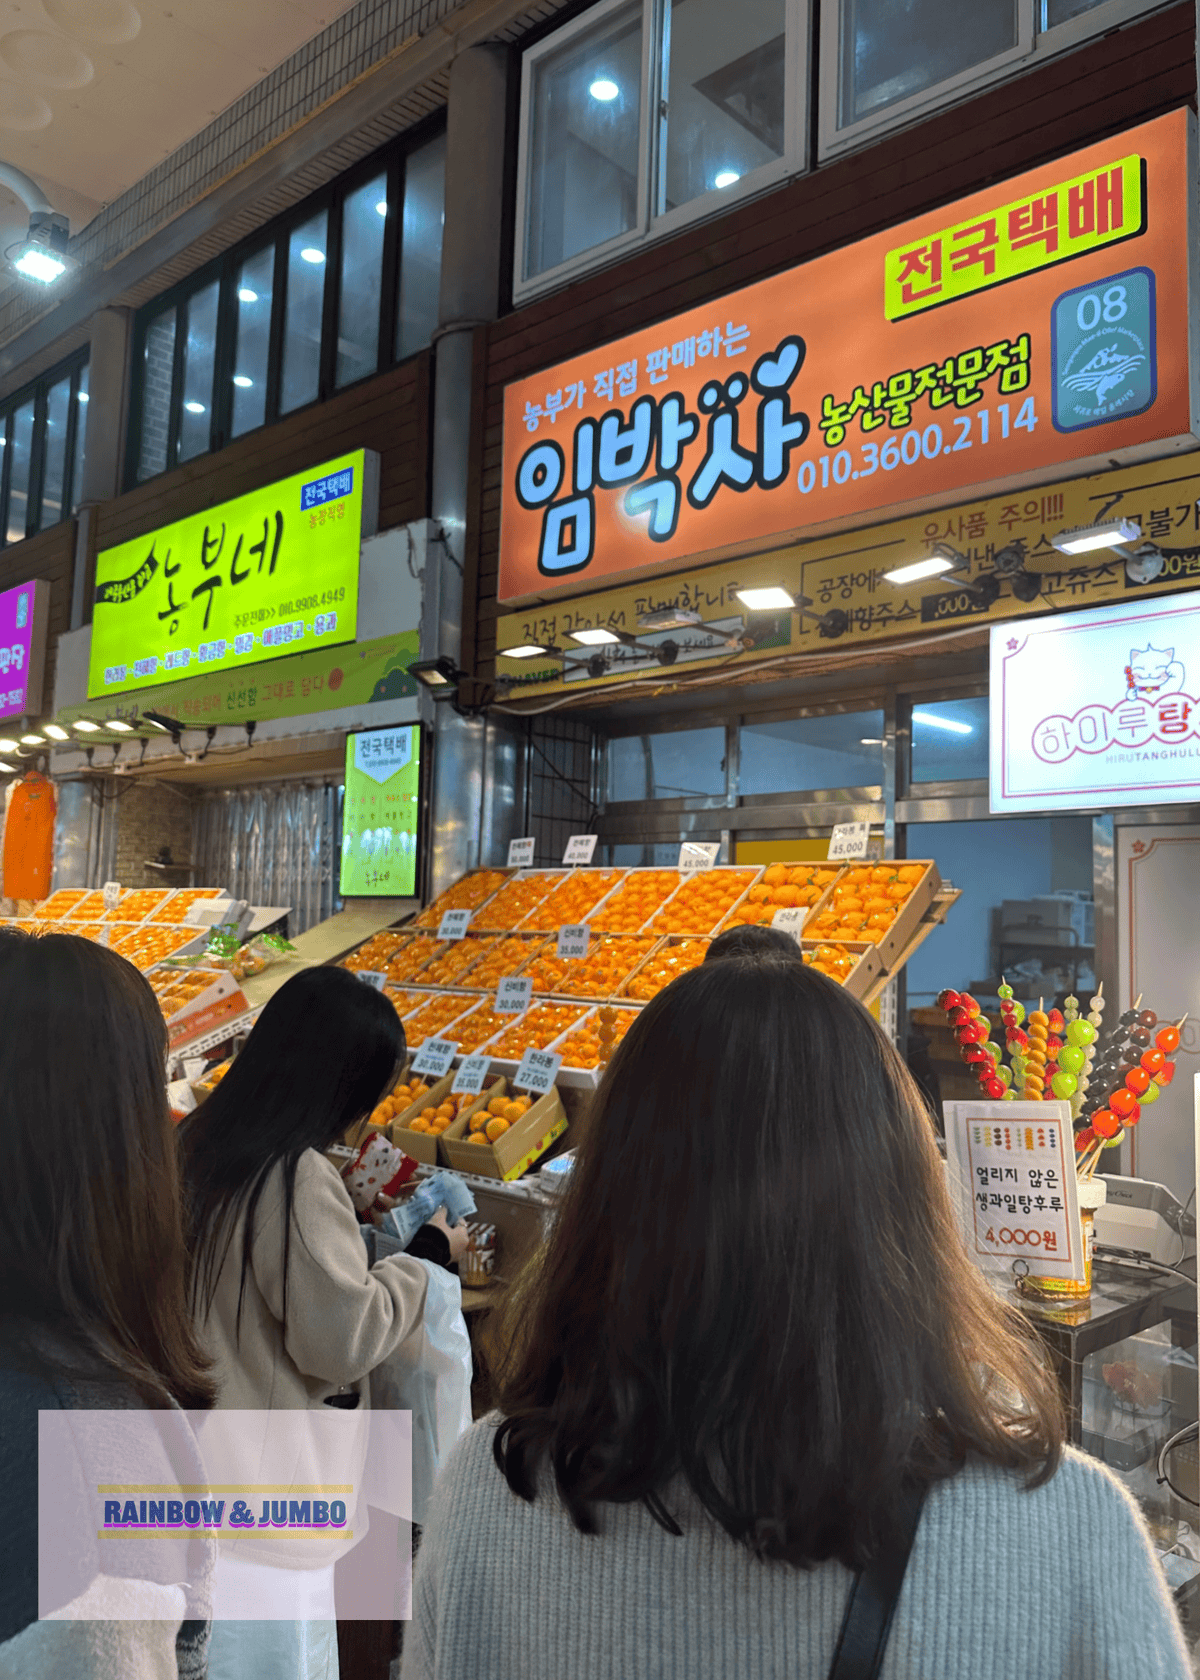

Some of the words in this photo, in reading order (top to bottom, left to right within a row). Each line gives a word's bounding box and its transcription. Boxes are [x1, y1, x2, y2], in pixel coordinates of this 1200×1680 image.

[896, 165, 1124, 304] 전국택배
[1077, 285, 1128, 331] 08
[522, 379, 587, 433] 농부가
[593, 358, 639, 402] 직접
[646, 321, 751, 385] 판매하는
[819, 333, 1032, 448] 농산물전문점
[797, 396, 1039, 494] 010.3600.2114
[304, 472, 352, 506] 전국택배
[515, 370, 810, 577] 임박사
[920, 511, 989, 549] 유사품
[998, 493, 1065, 532] 주의!!!
[158, 510, 284, 636] 농부네
[360, 733, 407, 758] 전국택배
[1040, 701, 1200, 755] 하이루탕
[832, 841, 864, 855] 45,000
[519, 1072, 549, 1088] 27,000
[528, 1052, 555, 1069] 한라봉
[976, 1167, 1018, 1186] 얼리지
[1028, 1169, 1059, 1189] 않은
[976, 1192, 1064, 1215] 생과일탕후루
[985, 1226, 1058, 1252] 4,000원
